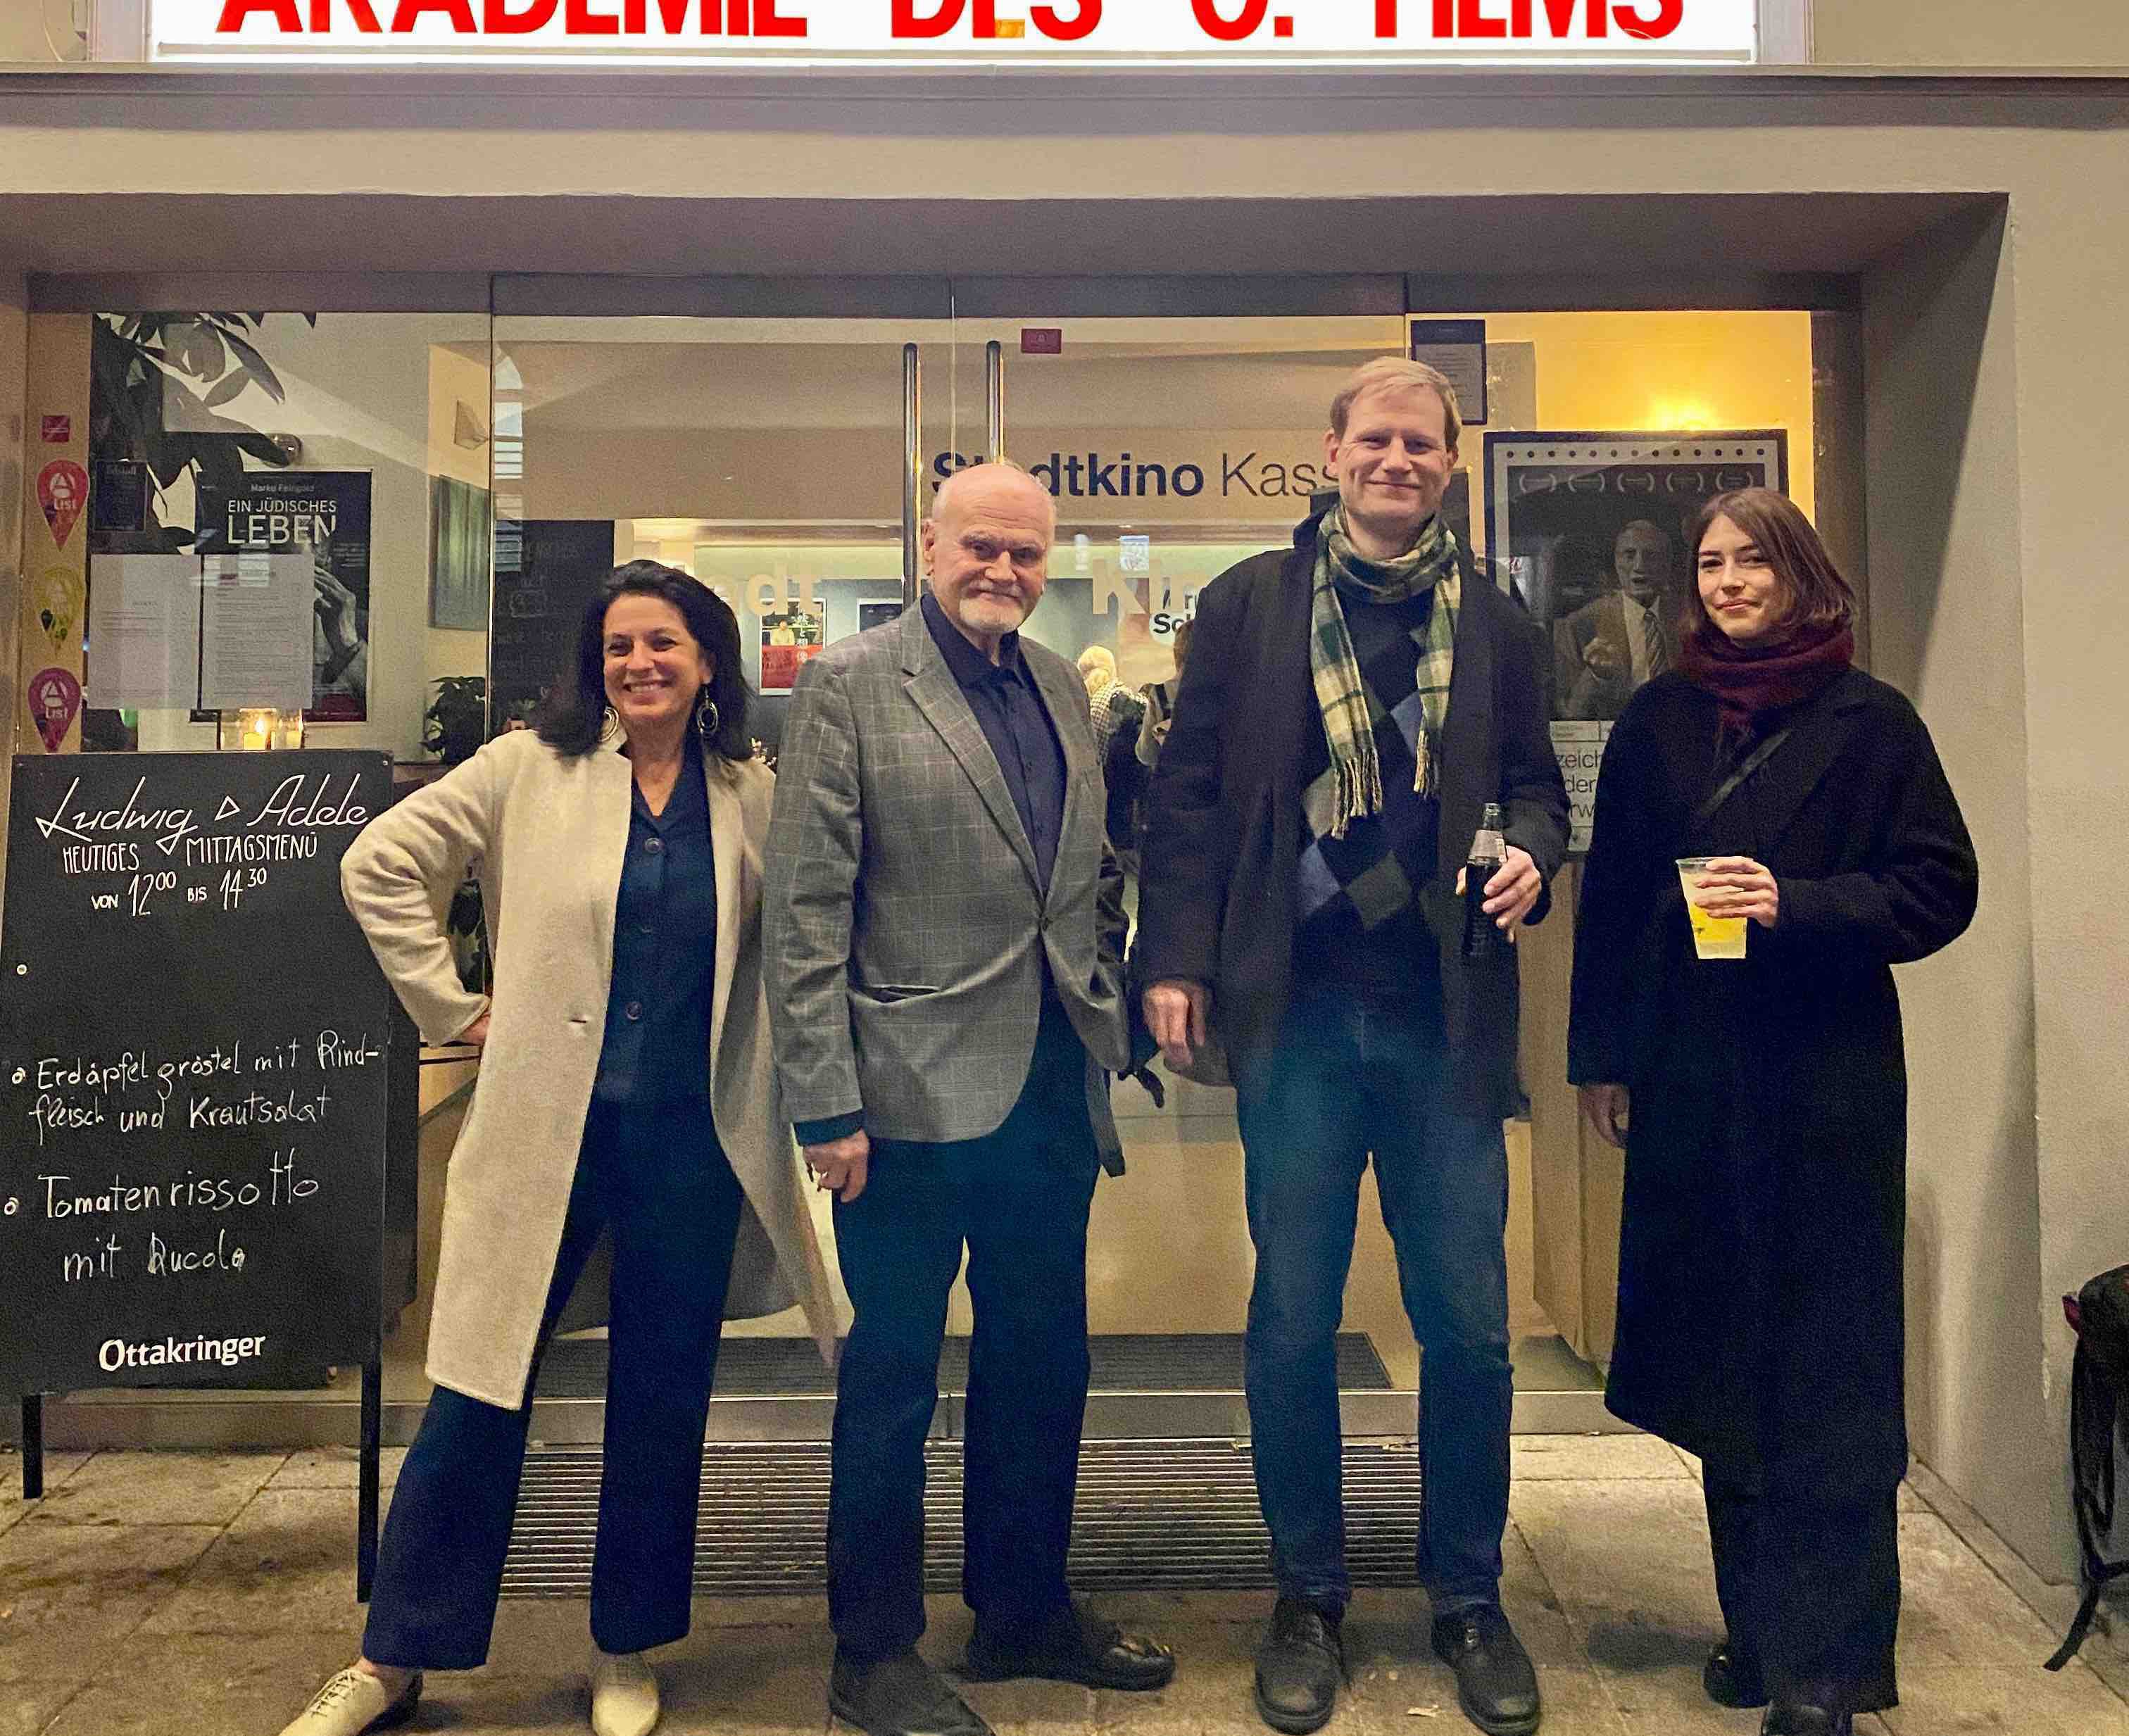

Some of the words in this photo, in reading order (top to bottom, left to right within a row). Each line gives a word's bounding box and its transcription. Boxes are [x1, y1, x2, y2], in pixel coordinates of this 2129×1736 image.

[932, 451, 1204, 496] Sdtkino
[227, 499, 251, 513] EIN
[256, 496, 337, 513] JÜDISCHES
[227, 514, 337, 544] LEBEN
[35, 776, 198, 855] Ludwig
[246, 774, 369, 827] Adele
[63, 843, 140, 874] HEUTIGES
[91, 894, 119, 910] VON
[187, 886, 208, 902] BIS
[255, 1036, 301, 1071] mit
[29, 1093, 105, 1146] fleisch
[120, 1098, 165, 1133] und
[189, 1085, 332, 1129] Krautsalat
[64, 1233, 121, 1282] mit
[147, 1228, 246, 1277] Rucola
[99, 1334, 266, 1371] Ottakringer
